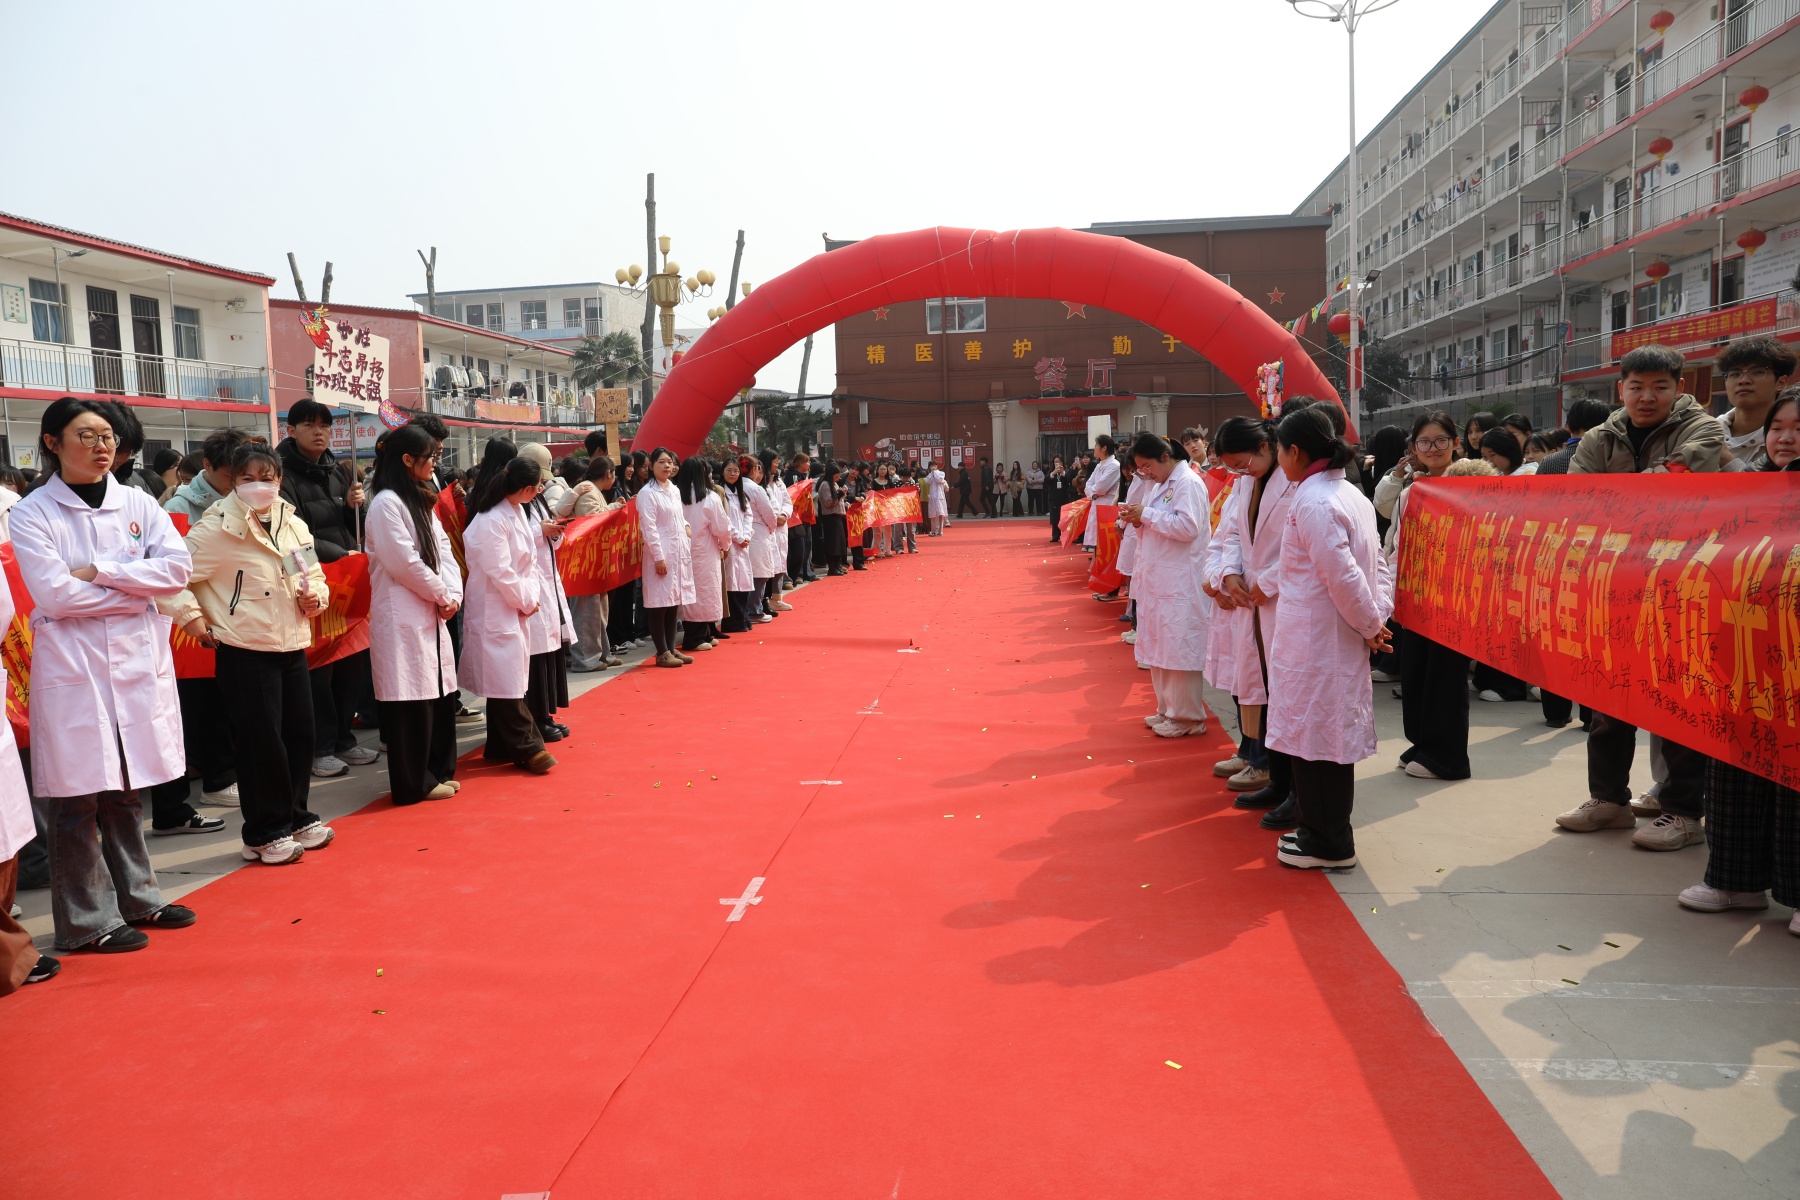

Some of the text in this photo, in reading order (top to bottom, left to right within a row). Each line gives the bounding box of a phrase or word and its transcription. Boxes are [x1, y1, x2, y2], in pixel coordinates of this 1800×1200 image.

[1780, 228, 1800, 241] 医学生
[1686, 304, 1771, 337] 今朝出鞘试锋芒
[322, 338, 384, 381] 斗志昂扬
[866, 338, 1032, 365] 精医善护
[315, 366, 383, 402] 六班最强
[1034, 357, 1116, 391] 餐厅
[1452, 511, 1632, 672] 以梦为马踏星河
